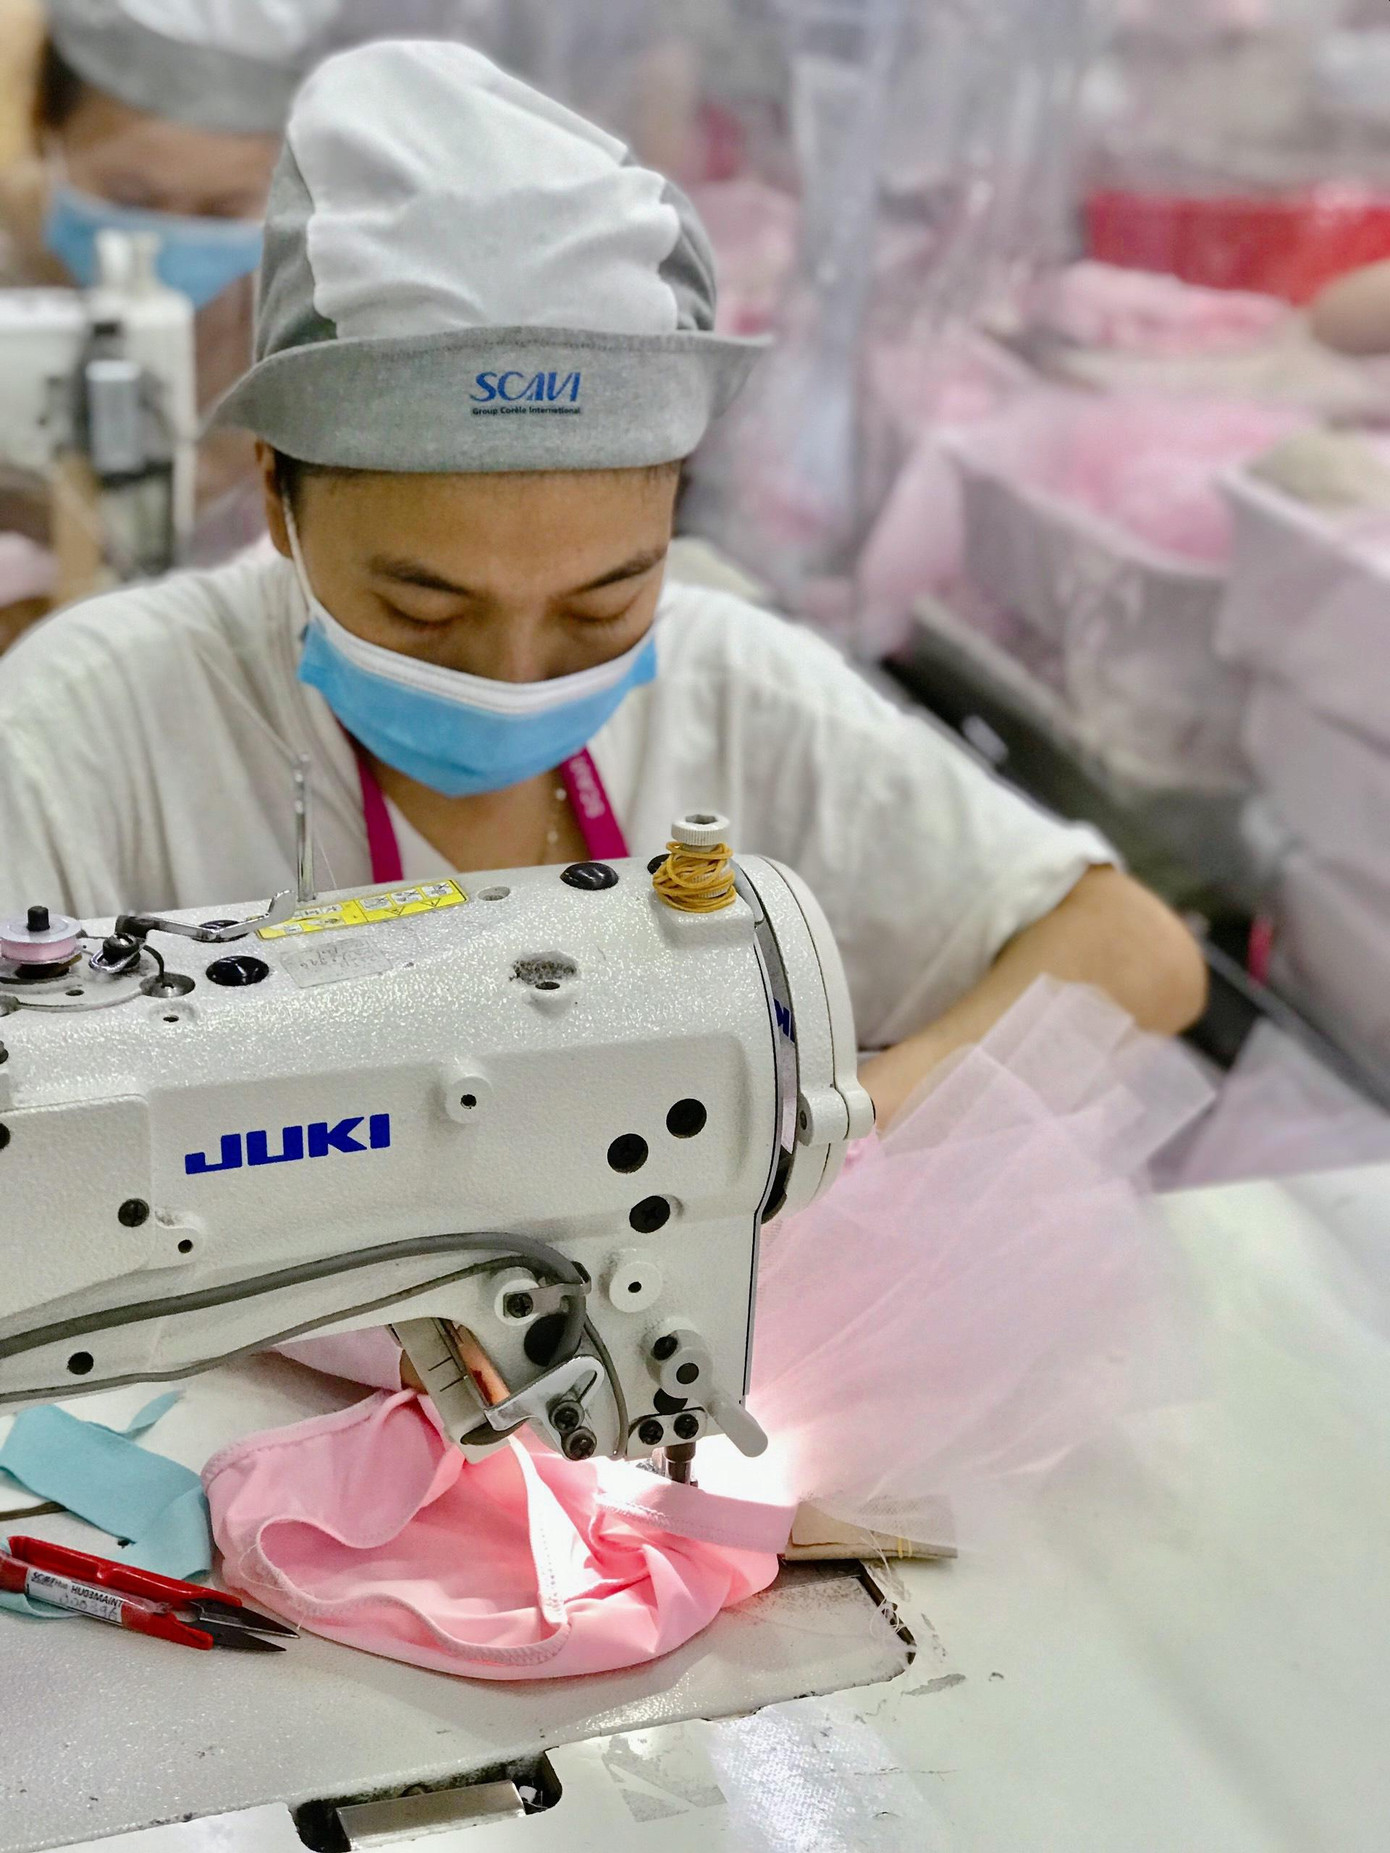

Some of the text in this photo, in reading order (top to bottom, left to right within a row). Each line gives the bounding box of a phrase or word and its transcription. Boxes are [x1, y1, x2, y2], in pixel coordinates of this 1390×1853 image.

[470, 371, 581, 402] SCAVI
[472, 407, 498, 416] Group
[185, 1113, 390, 1175] JUKI
